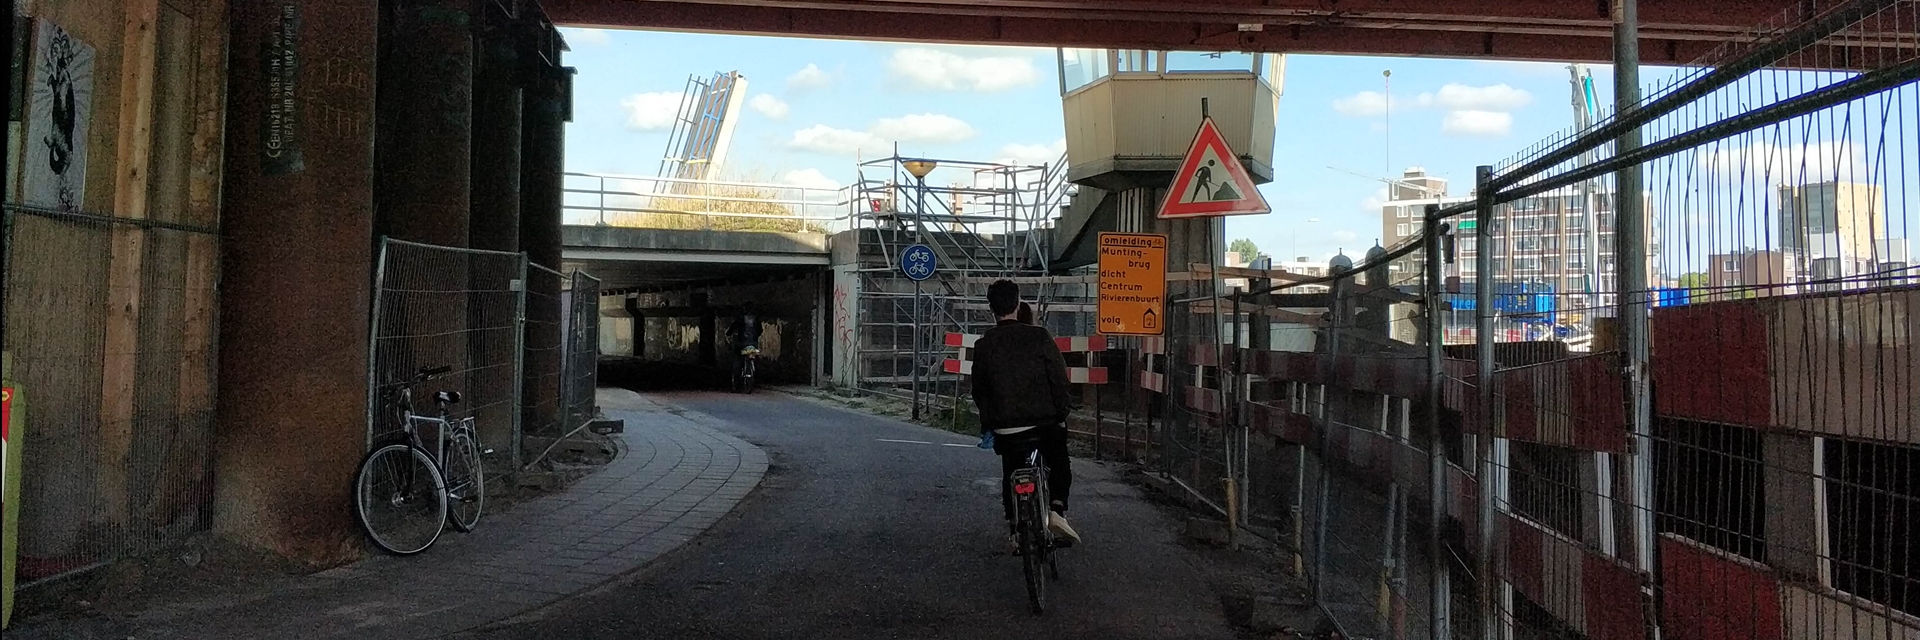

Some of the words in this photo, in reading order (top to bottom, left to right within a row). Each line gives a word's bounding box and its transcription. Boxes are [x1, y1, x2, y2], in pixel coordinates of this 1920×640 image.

[1105, 237, 1152, 247] omleiding
[1101, 247, 1147, 259] Munting-
[1129, 260, 1150, 270] brug
[1101, 270, 1126, 278] dicht
[1101, 282, 1142, 291] Centrum
[1101, 294, 1159, 303] Rivierenbuurt
[1101, 316, 1121, 325] volg
